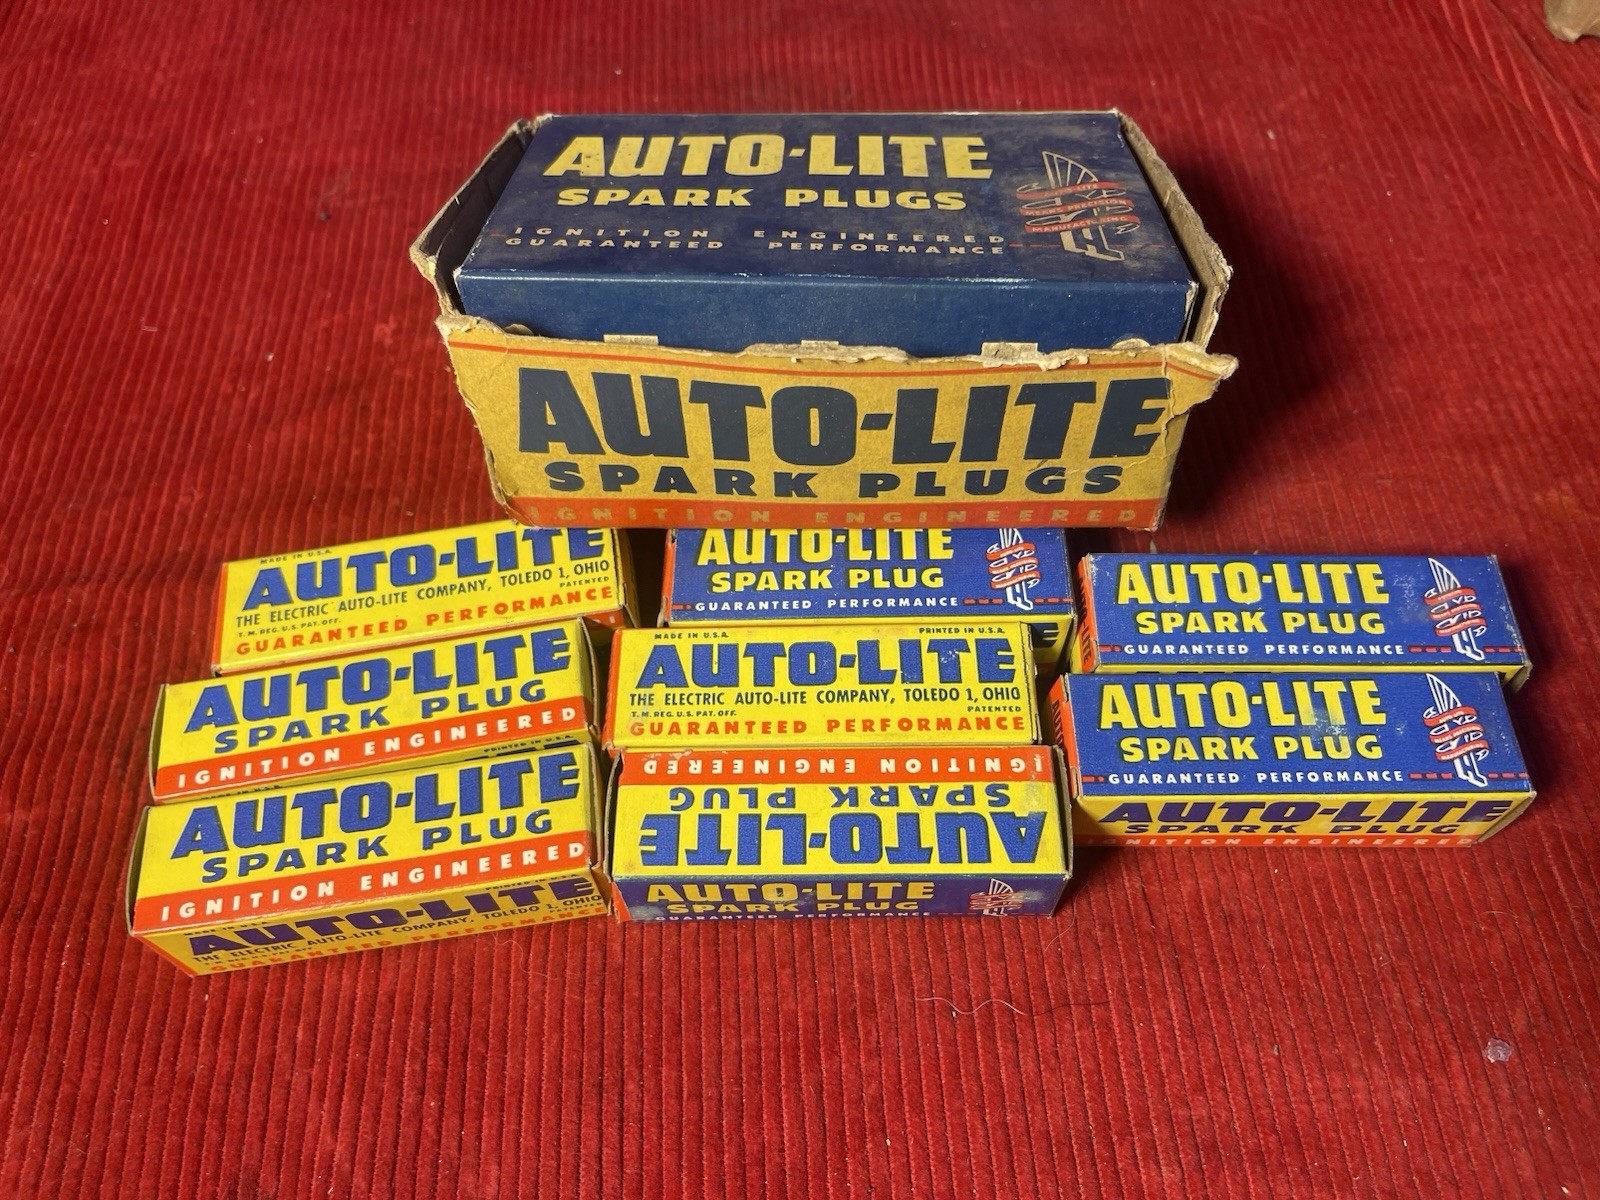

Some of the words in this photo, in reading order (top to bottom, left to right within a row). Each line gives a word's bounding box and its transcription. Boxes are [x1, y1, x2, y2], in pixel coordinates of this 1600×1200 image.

[543, 134, 994, 179] AUTO-LITE
[556, 188, 754, 208] SPARK
[785, 188, 967, 211] PLUGS
[505, 237, 724, 250] GUARANTEED
[768, 241, 1004, 255] PERFORMANCE
[515, 226, 709, 238] IGNITION
[753, 230, 1005, 244] ENGINEERED
[518, 367, 1172, 466] AUTO-LITE
[544, 461, 819, 498] SPARK
[858, 465, 1123, 498] PLUGS
[530, 507, 771, 522] IGNITION
[815, 508, 1136, 524] ENGINEERED
[697, 528, 954, 566] AUTO-LITE
[242, 528, 605, 611] AUTO-LITE
[259, 556, 288, 565] MADE
[559, 576, 610, 588] PATENTED
[711, 569, 833, 593] SPARK
[848, 567, 944, 589] PLUG
[1117, 562, 1390, 604] AUTO-LITE
[236, 613, 261, 628] THE
[270, 603, 329, 623] ELECTRIC
[338, 591, 408, 613] AUTO-LITE
[416, 578, 492, 600] COMPANY,
[500, 568, 552, 588] TOLEDO
[558, 566, 570, 580] 1,
[573, 559, 610, 576] OHIO
[695, 600, 812, 611] GUARANTEED
[827, 597, 958, 609] PERFORMANCE
[236, 619, 408, 655] GUARANTEED
[426, 586, 612, 626] PERFORMANCE
[1135, 611, 1268, 634] SPARK
[1282, 612, 1386, 634] PLUG
[654, 632, 683, 640] MADE
[1123, 644, 1249, 655] GUARANTEED
[1265, 644, 1404, 655] PERFORMANCE
[635, 638, 1016, 689] AUTO-LITE
[184, 628, 571, 733] AUTO-LITE
[629, 693, 655, 706] THE
[664, 692, 725, 705] ELECTRIC
[734, 691, 807, 705] AUTO-LITE
[816, 689, 895, 704] COMPANY,
[903, 688, 960, 702] TOLEDO
[966, 687, 979, 703] 1,
[982, 687, 1021, 700] OHIO
[1100, 680, 1387, 729] AUTO-LITE
[214, 705, 390, 754] SPARK
[421, 679, 547, 719] PLUG
[629, 720, 808, 736] GUARANTEED
[826, 716, 1025, 733] PERFORMANCE
[178, 748, 340, 788] IGNITION
[364, 707, 576, 756] ENGINEERED
[1120, 736, 1259, 762] SPARK
[1273, 734, 1383, 760] PLUG
[643, 758, 856, 775] ENGINEERED
[880, 757, 1043, 773] IGNITION
[1108, 772, 1240, 785] GUARANTEED
[1256, 770, 1404, 783] PERFORMANCE
[170, 752, 580, 859] AUTO-LITE
[669, 786, 796, 812] PLUG
[829, 783, 1011, 808] SPARK
[1098, 800, 1514, 823] AUTO-LITE
[638, 811, 1047, 866] AUTO-LITE
[1124, 824, 1300, 834] SPARK
[1328, 824, 1461, 834] PLUG
[202, 834, 389, 883] SPARK
[422, 809, 553, 850] PLUG
[161, 881, 335, 922] IGNITION
[360, 842, 585, 891] ENGINEERED
[647, 882, 936, 903] AUTO-LITE
[189, 877, 595, 956] AUTO-LITE
[666, 902, 800, 914] SPARK
[817, 901, 919, 911] PLUG
[193, 954, 221, 963] THE
[230, 943, 295, 957] ELECTRIC
[307, 929, 383, 946] AUTO-LITE
[392, 915, 475, 933] COMPANY,
[482, 905, 540, 920] TOLEDO
[562, 894, 602, 907] OHIO
[210, 940, 393, 971] GUARANTEED
[412, 907, 608, 941] PERFORMANCE
